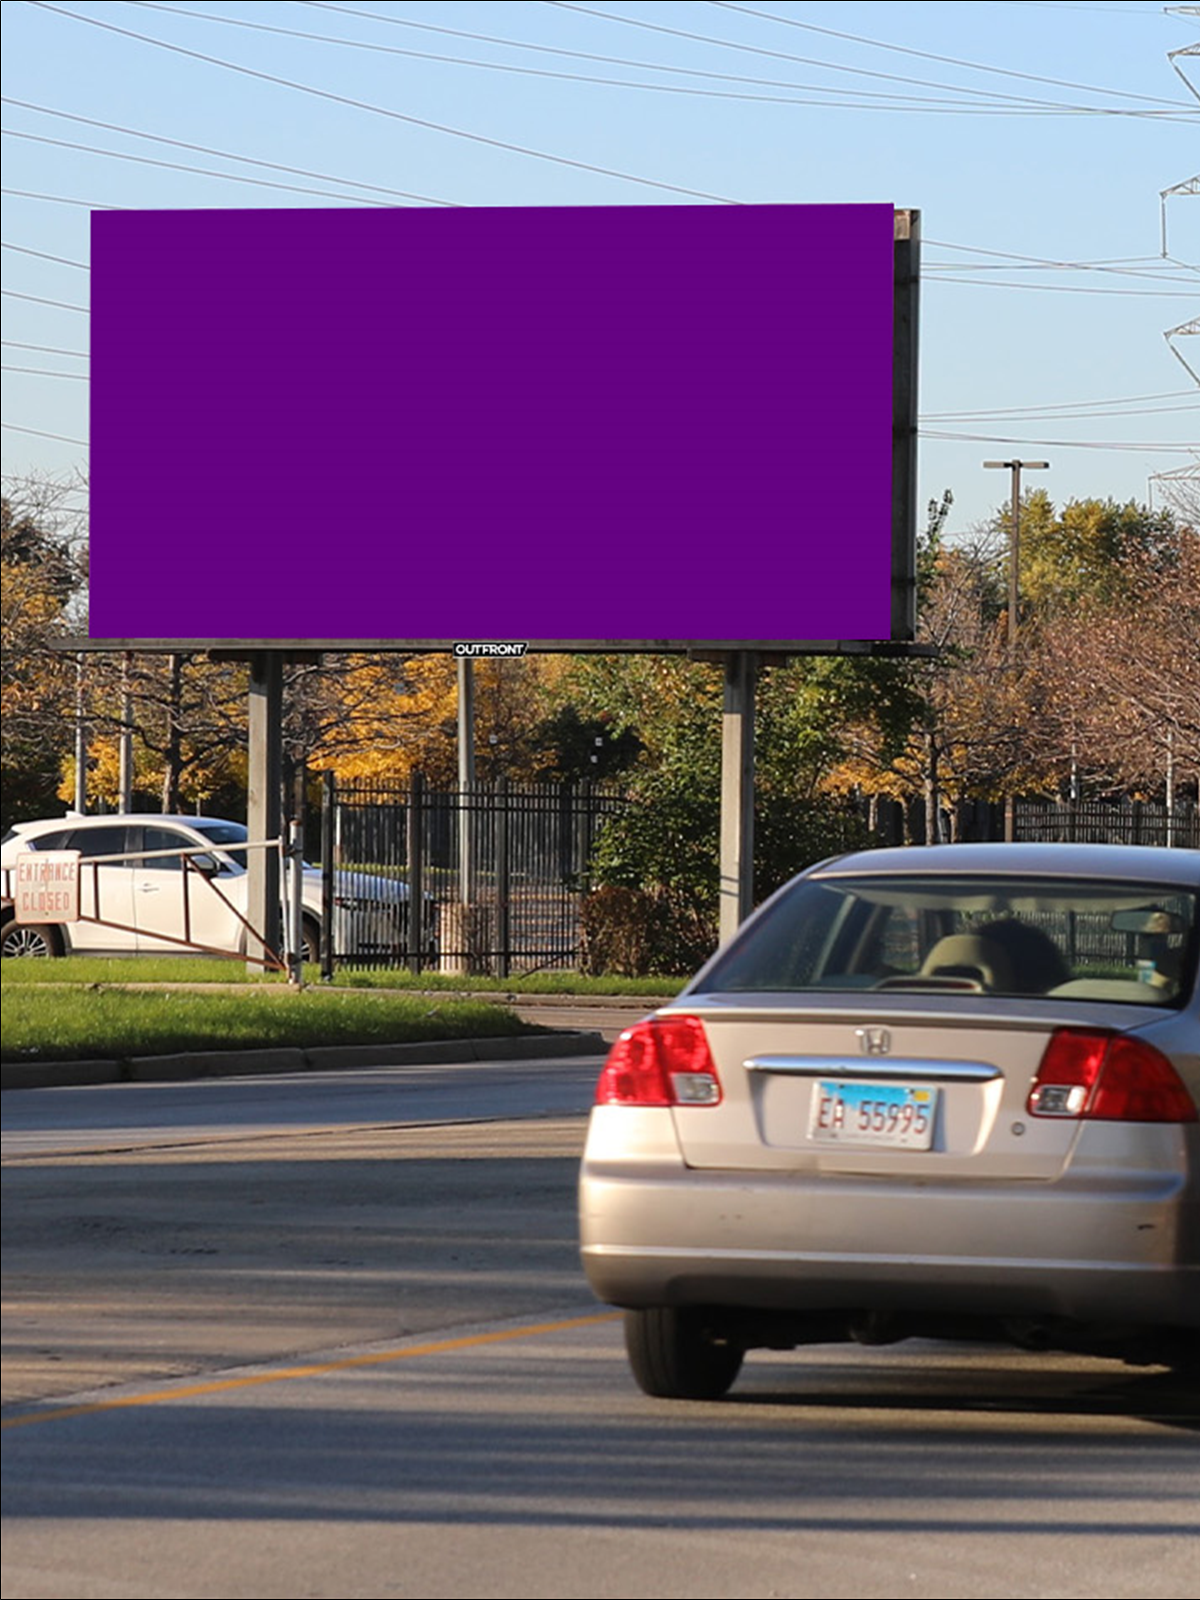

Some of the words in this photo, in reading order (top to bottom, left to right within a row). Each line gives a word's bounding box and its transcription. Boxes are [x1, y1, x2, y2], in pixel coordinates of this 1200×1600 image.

[455, 644, 524, 655] OUTFRONT
[19, 862, 76, 882] ENTRANCE
[22, 891, 70, 911] CLOSED
[818, 1098, 844, 1128] EA
[858, 1100, 930, 1134] 55995
